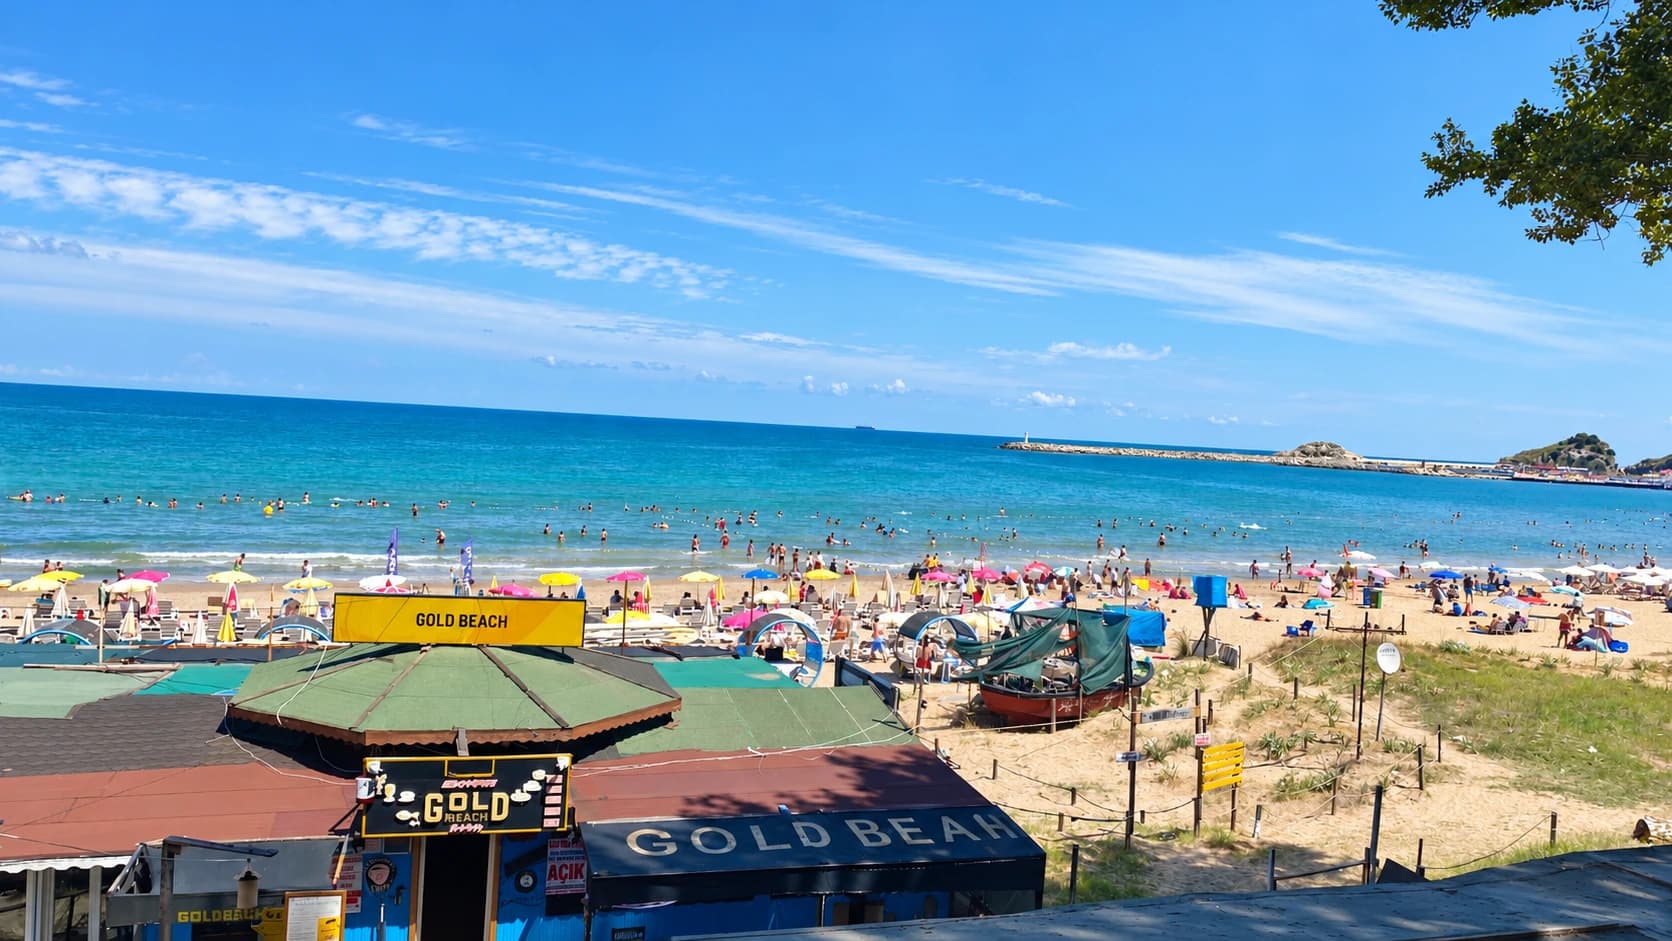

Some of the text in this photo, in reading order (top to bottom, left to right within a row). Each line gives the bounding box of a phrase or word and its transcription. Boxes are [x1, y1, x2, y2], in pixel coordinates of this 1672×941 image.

[416, 613, 508, 628] GOLD BEACH
[424, 791, 510, 823] GOLD
[626, 813, 1018, 857] GOLD BEAH
[547, 863, 585, 884] AÇIK
